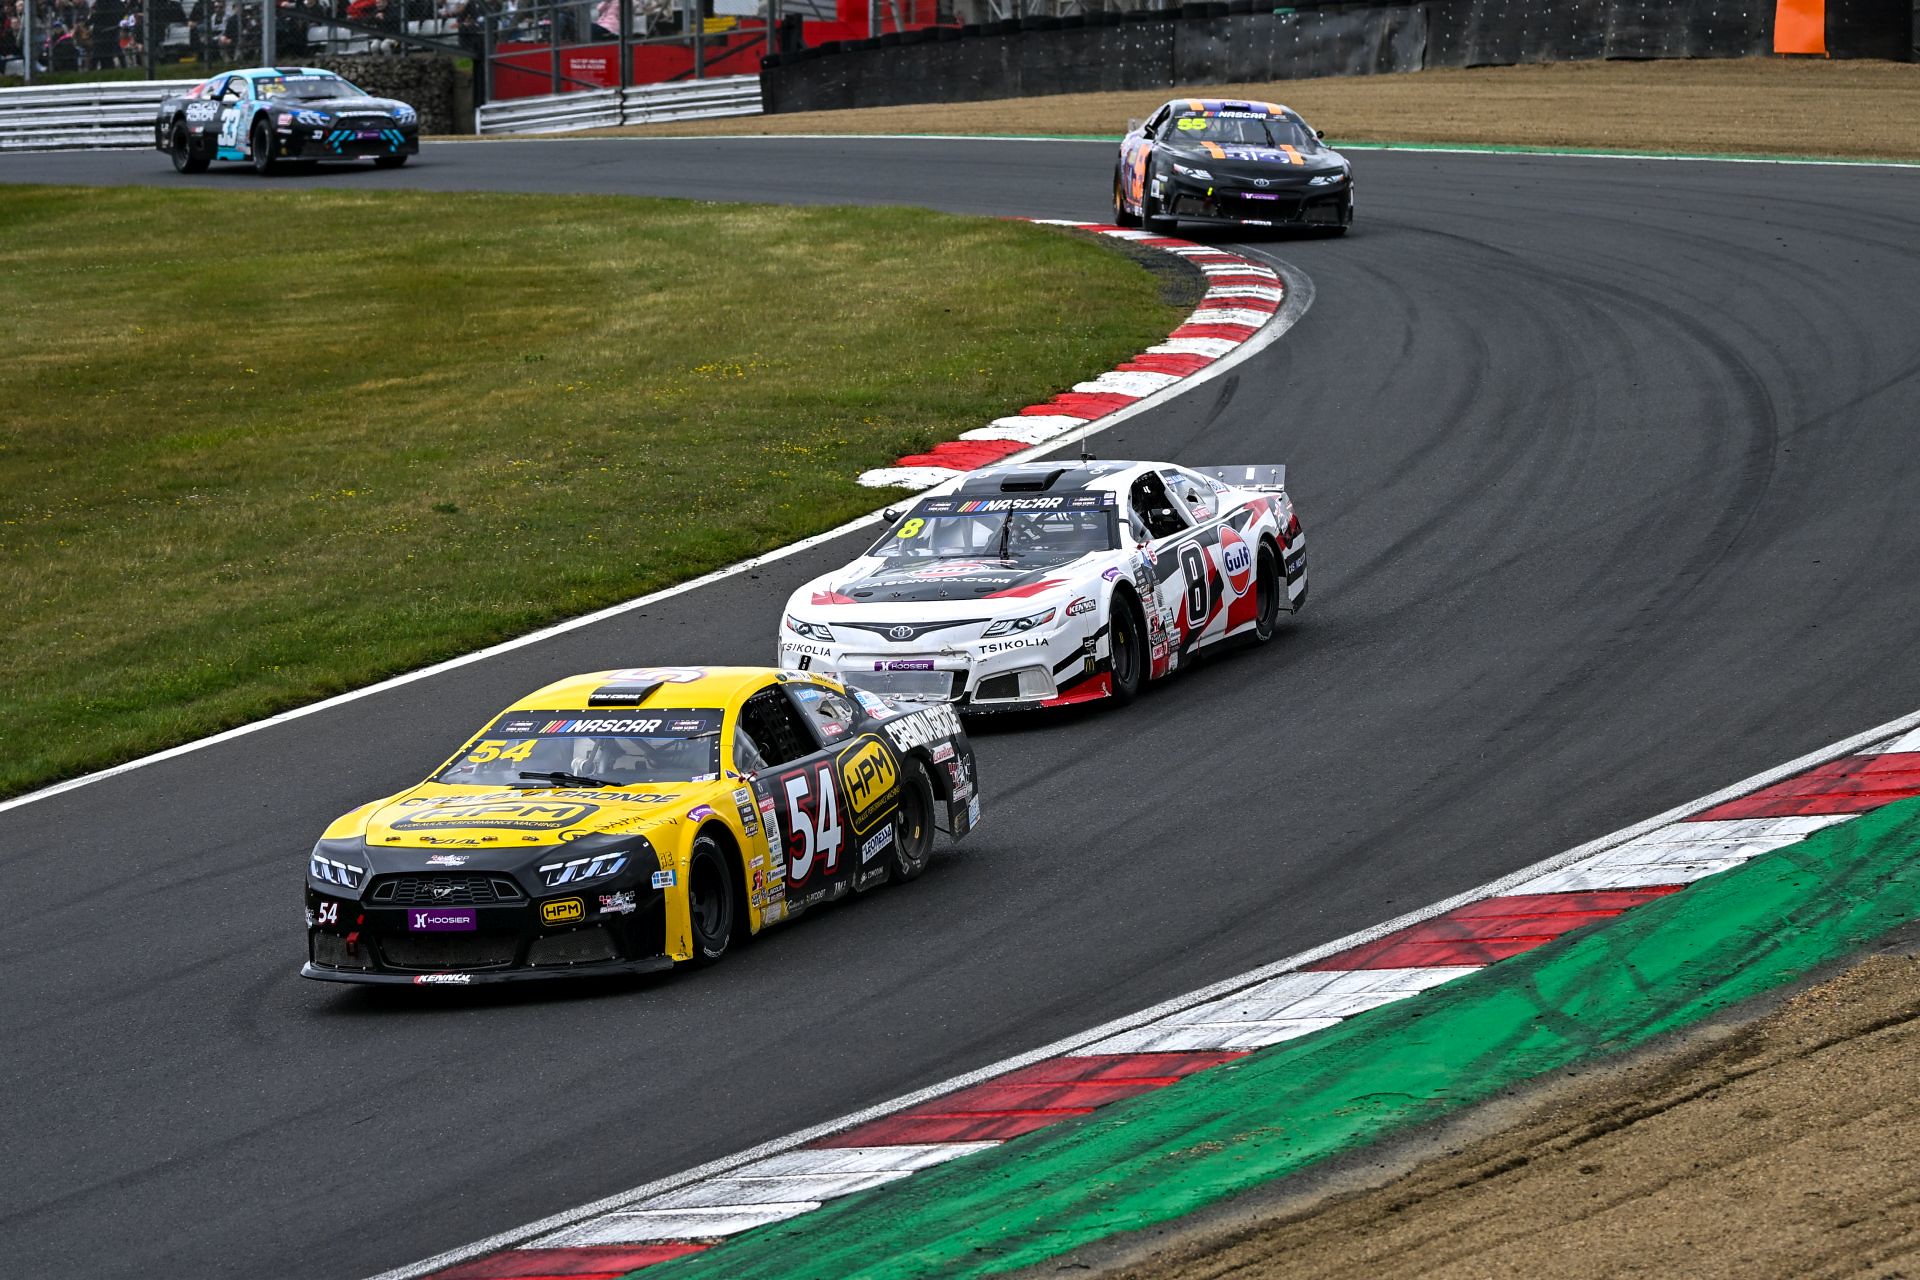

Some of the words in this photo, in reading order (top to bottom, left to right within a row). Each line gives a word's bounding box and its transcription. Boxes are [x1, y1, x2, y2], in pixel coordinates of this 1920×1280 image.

[1219, 111, 1266, 119] NASCAR
[217, 109, 240, 147] 33
[1177, 118, 1206, 130] 55
[983, 497, 1063, 511] NASCAR
[897, 518, 925, 538] 8
[1224, 547, 1250, 573] Gulf
[1178, 540, 1210, 629] 8
[1069, 600, 1096, 614] KENNOL
[783, 643, 831, 657] TSIKOLIA
[978, 637, 1049, 655] TSIKOLIA
[891, 662, 928, 671] HOOSIER
[566, 719, 662, 733] NASCAR
[468, 740, 538, 763] 54
[852, 747, 893, 806] HPM
[552, 790, 681, 802] GRONDE
[418, 805, 577, 819] HPM
[513, 820, 562, 829] MACHINES
[785, 766, 843, 881] 54
[865, 825, 891, 854] LEONESSA
[318, 902, 338, 924] 54
[545, 903, 579, 918] HPM
[427, 916, 470, 924] HOOSIER
[418, 973, 471, 982] KENNOL
